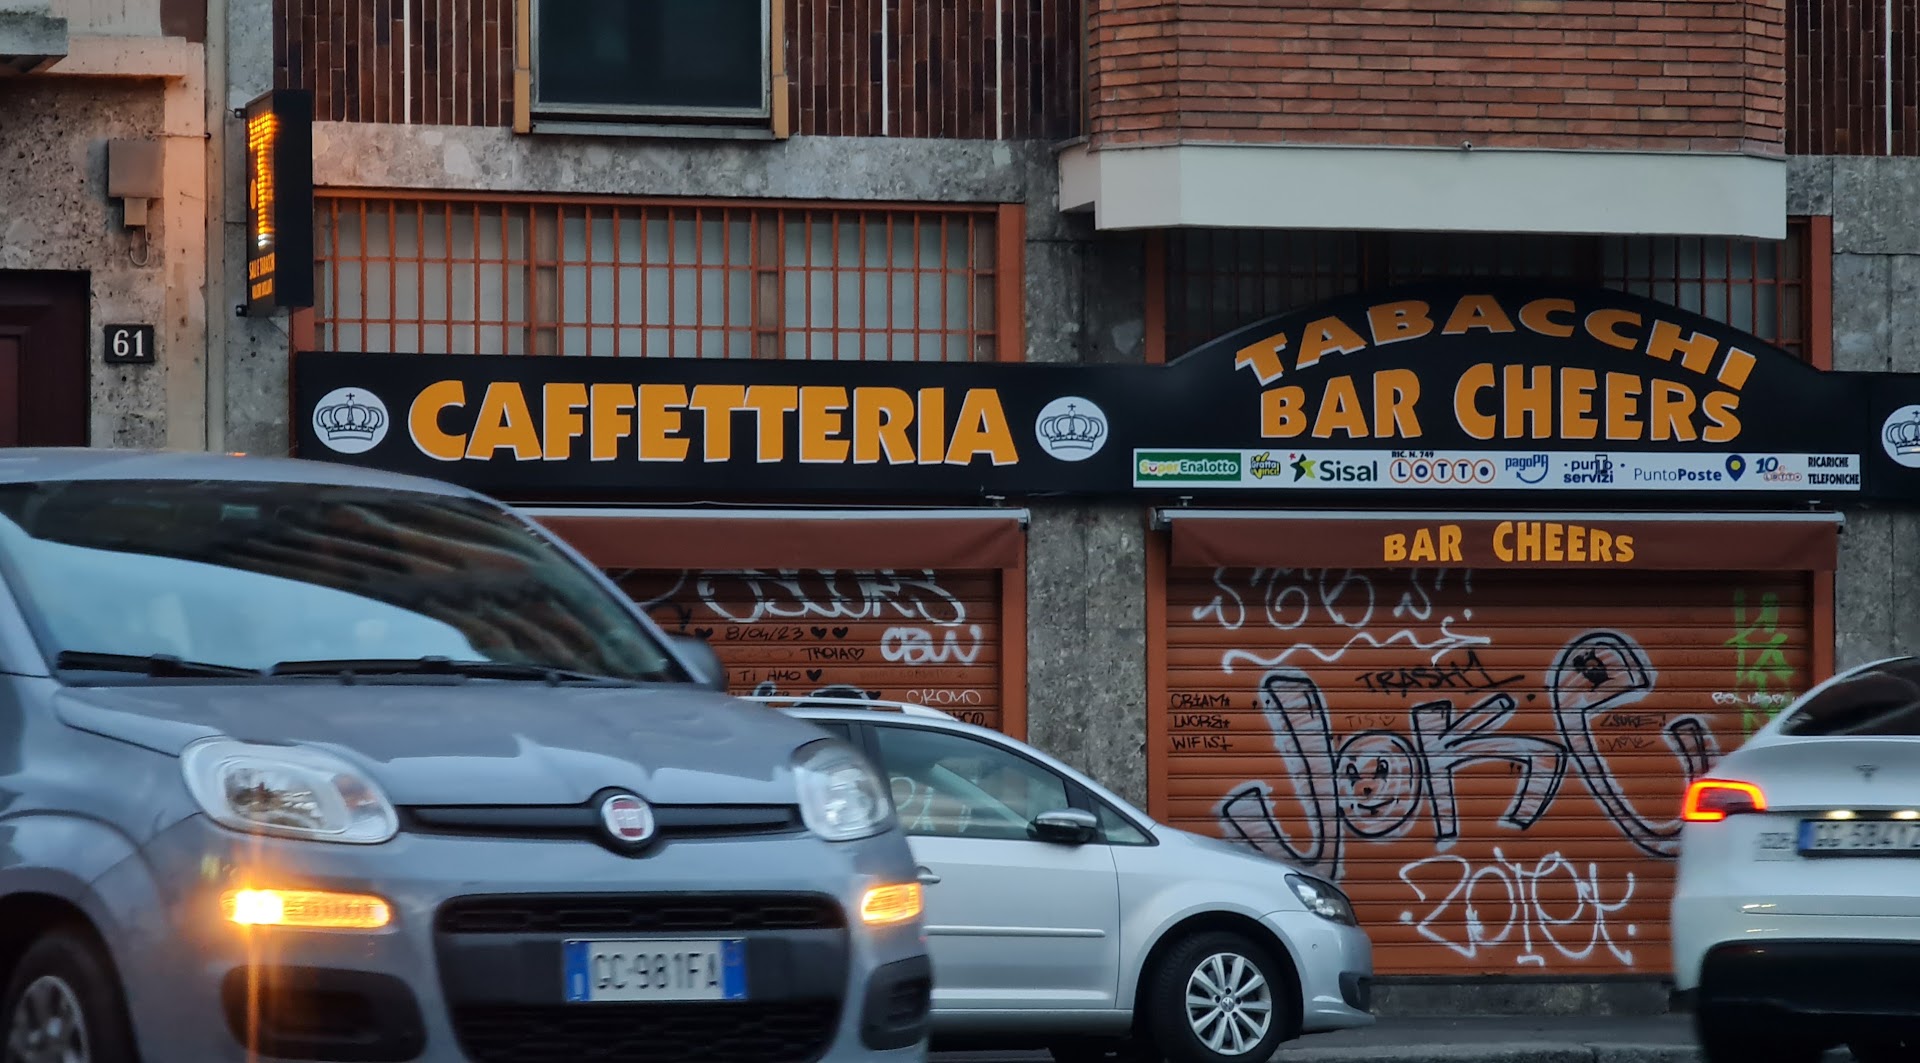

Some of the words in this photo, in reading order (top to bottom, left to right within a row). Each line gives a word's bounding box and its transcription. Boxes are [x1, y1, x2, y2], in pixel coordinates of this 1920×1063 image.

[111, 330, 145, 357] 61
[1234, 293, 1757, 392] TABACCHI
[1260, 366, 1424, 440] BAR
[1453, 362, 1744, 443] CHEERS
[407, 378, 1020, 469] CAFFETTERIA
[1391, 450, 1407, 458] RIC.
[1420, 450, 1434, 458] 749
[1505, 454, 1550, 472] pagoPA
[1807, 456, 1850, 468] RICARICHE
[1319, 460, 1378, 482] Sisal
[1391, 459, 1494, 483] LOTTO
[1634, 467, 1723, 482] PuntoPoste
[1755, 456, 1779, 474] 10
[1563, 471, 1614, 484] servizi
[1807, 472, 1861, 486] TELEFONICHE
[1383, 523, 1463, 563] BAR
[1492, 520, 1636, 563] CHEERS
